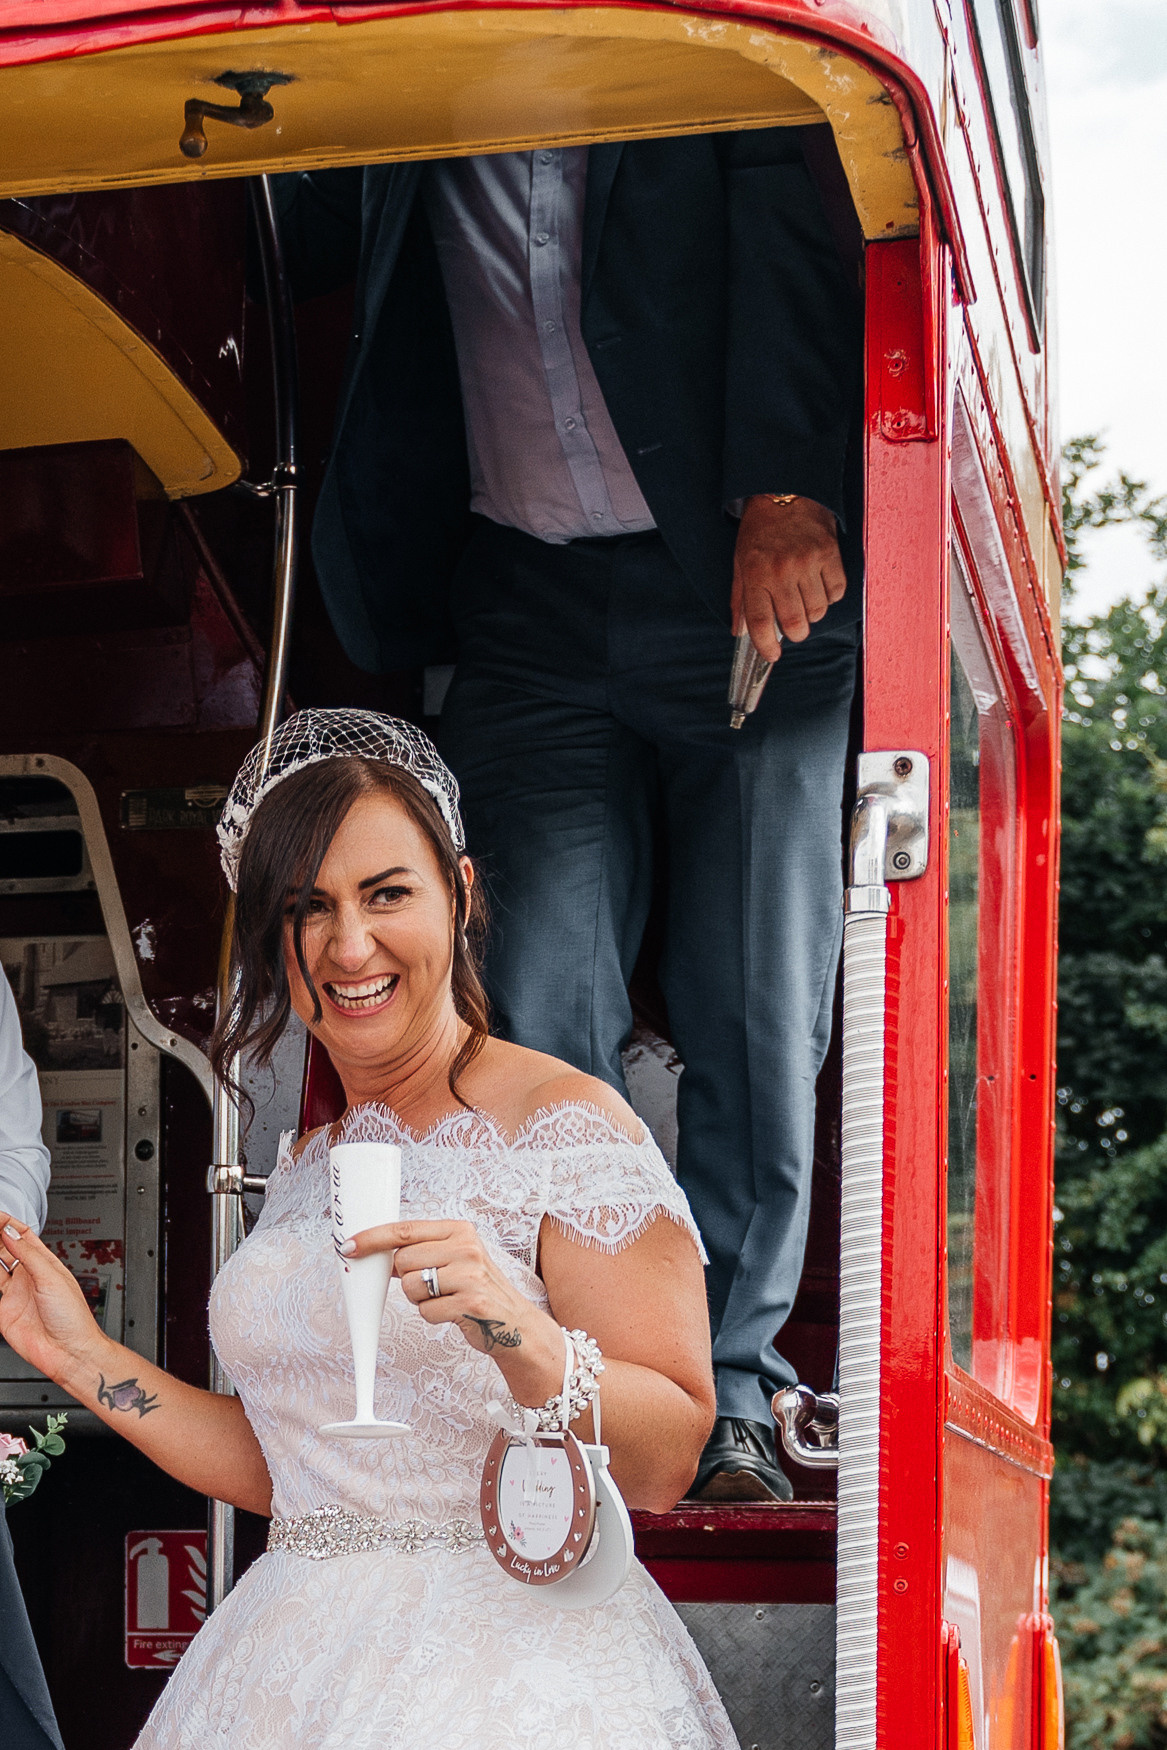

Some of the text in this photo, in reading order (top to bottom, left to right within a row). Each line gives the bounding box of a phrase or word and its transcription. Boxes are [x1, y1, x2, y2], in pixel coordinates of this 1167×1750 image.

[65, 1216, 101, 1225] Billboard
[510, 1555, 531, 1583] Lucky
[533, 1567, 543, 1576] in
[133, 1639, 190, 1652] Fire exting
